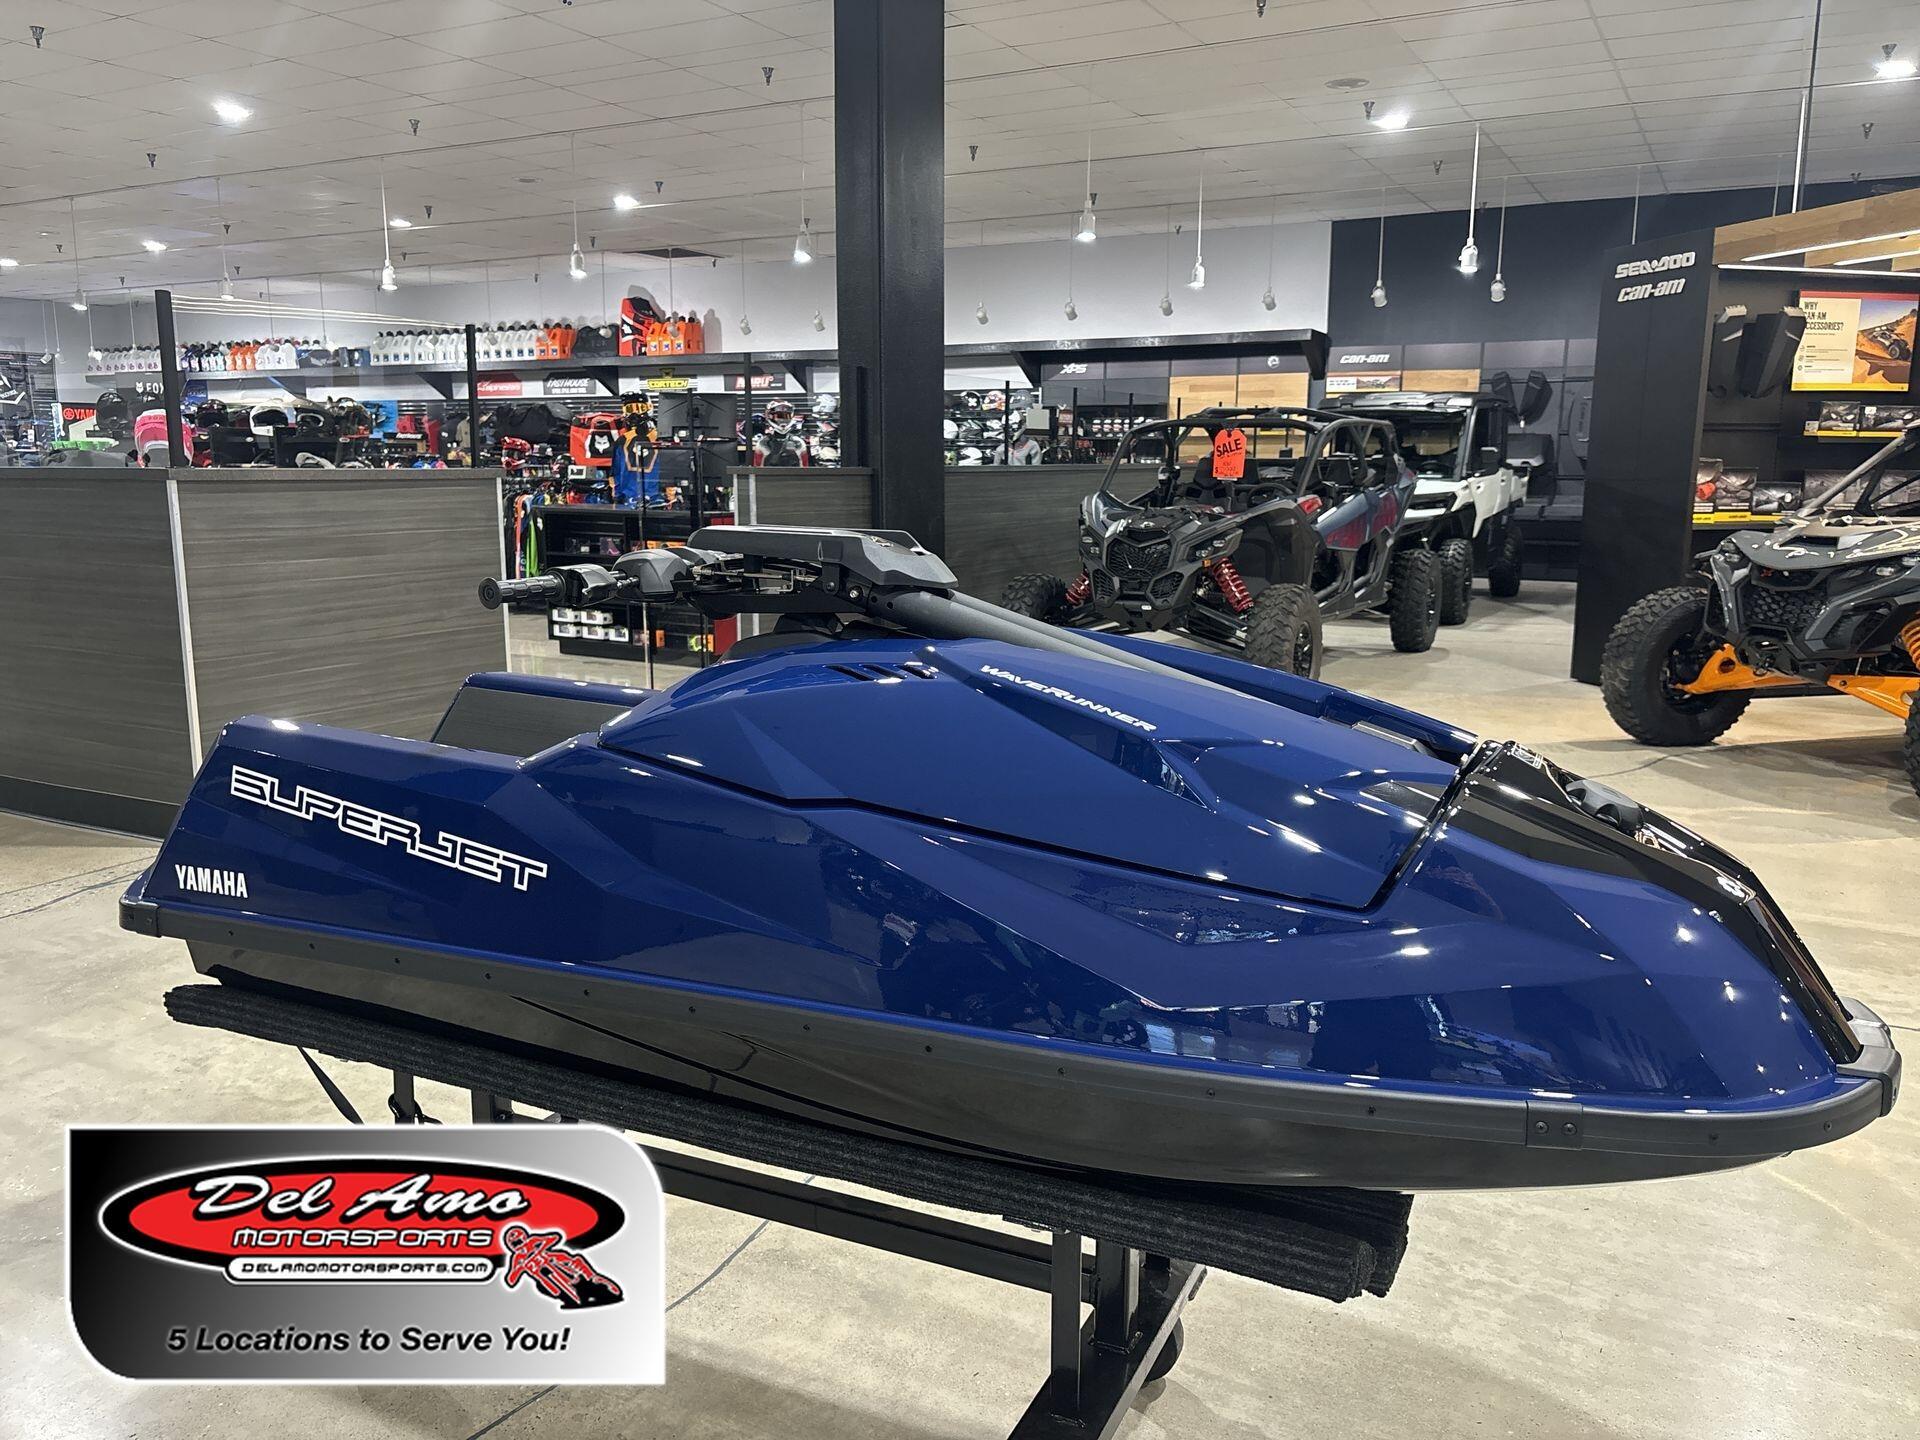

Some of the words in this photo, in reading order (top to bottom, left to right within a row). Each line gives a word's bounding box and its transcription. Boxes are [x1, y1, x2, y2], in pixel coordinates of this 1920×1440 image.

[1804, 301, 1819, 310] WHY
[1804, 322, 1844, 331] CCESSORIES?
[1216, 438, 1242, 457] SALE
[980, 664, 1157, 732] WAVERUNNER
[230, 764, 548, 892] SUPERJET
[175, 864, 249, 899] YAMAHA
